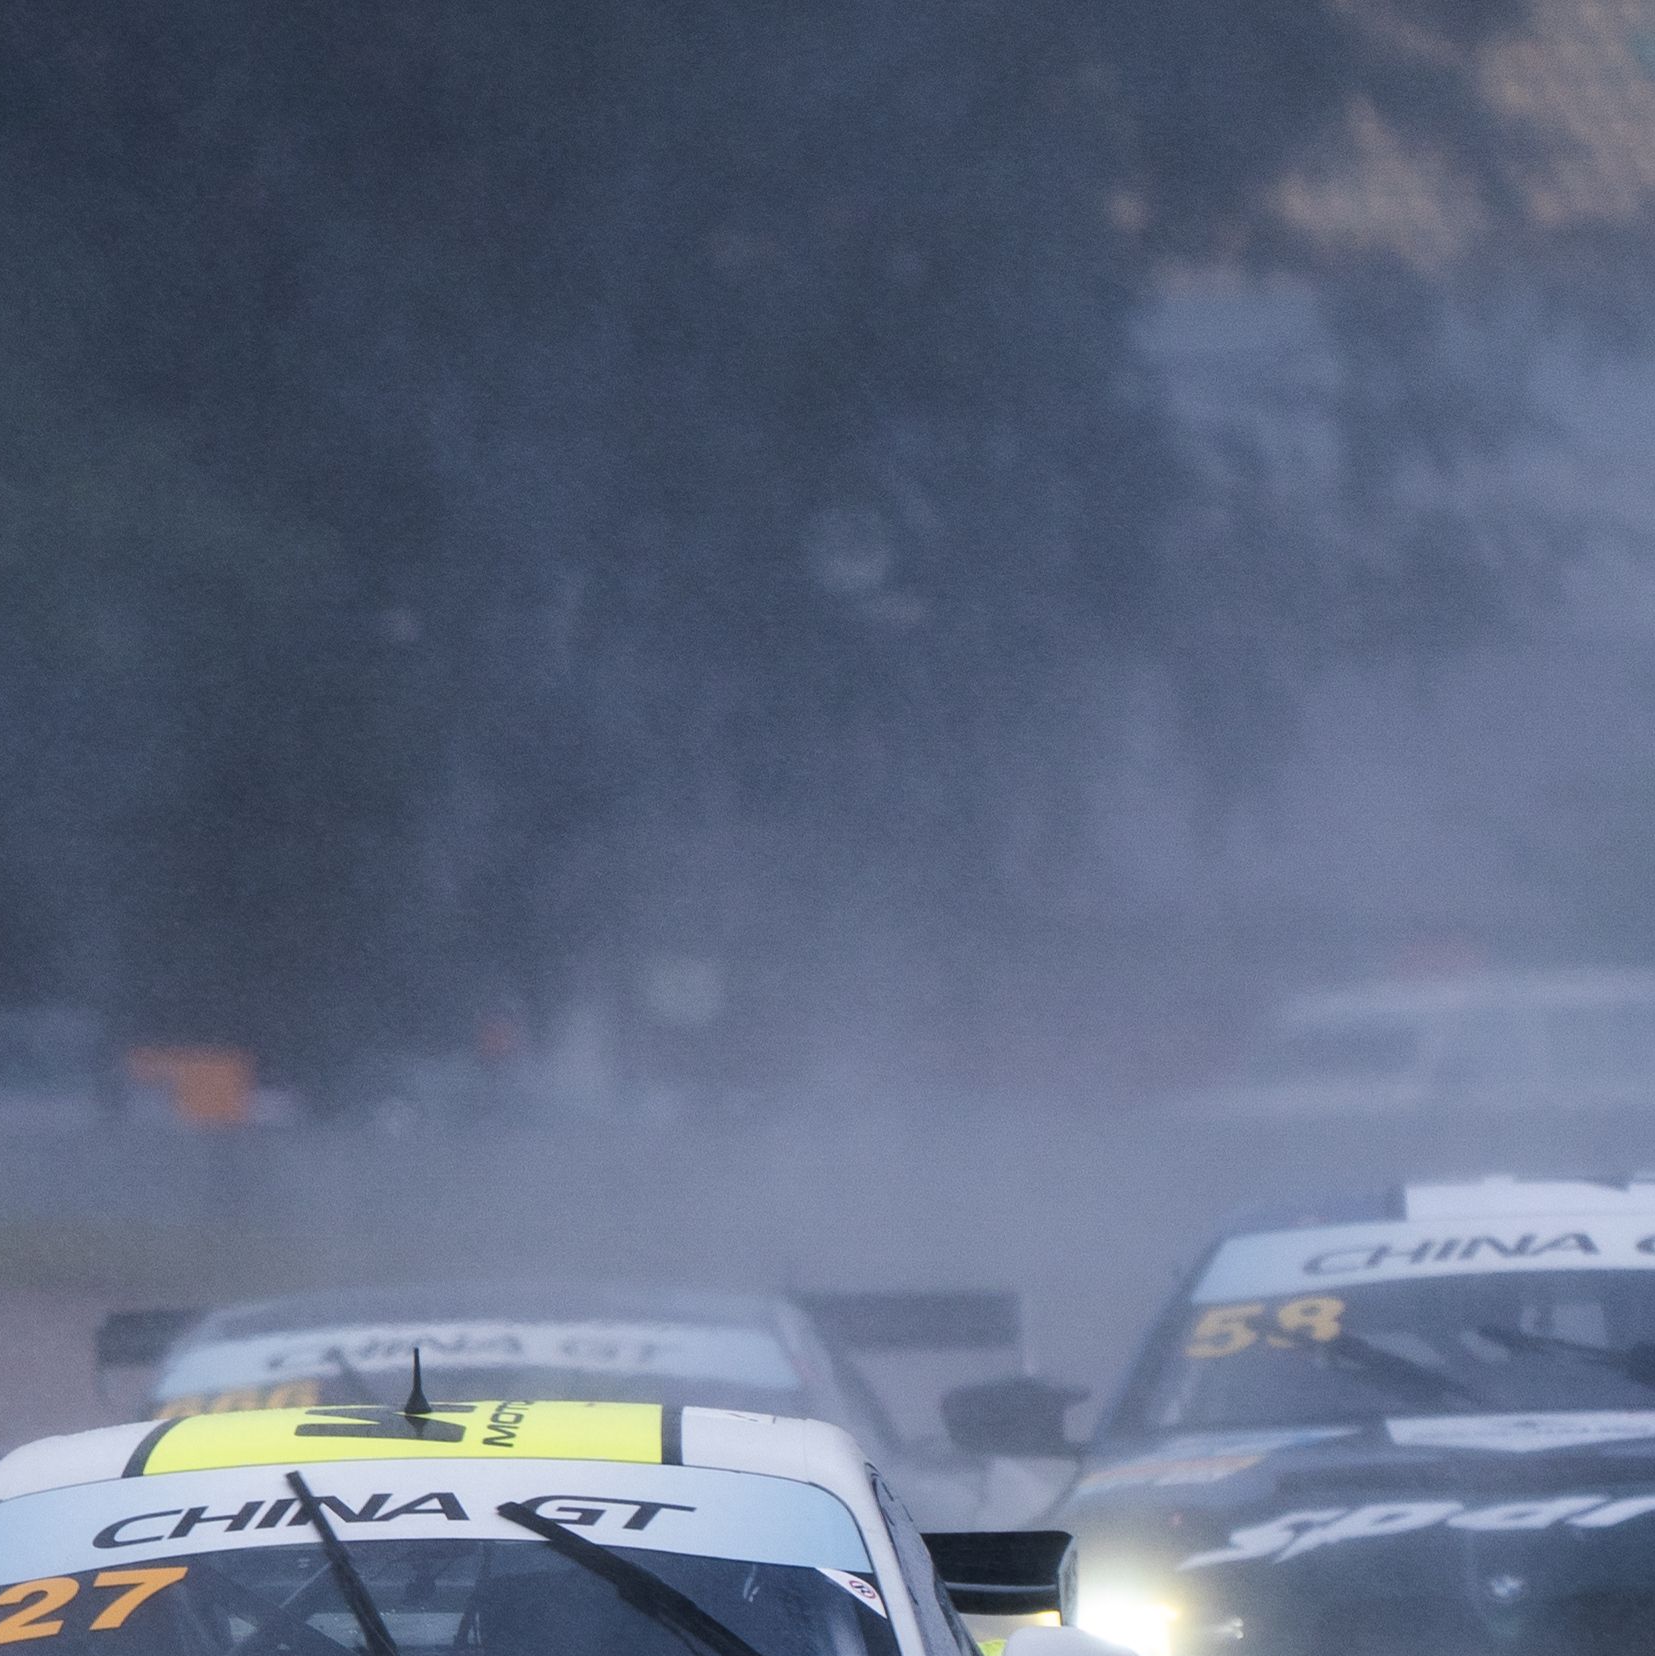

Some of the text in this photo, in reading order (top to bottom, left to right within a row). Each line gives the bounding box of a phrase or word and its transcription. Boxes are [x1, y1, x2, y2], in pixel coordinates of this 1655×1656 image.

[1302, 1231, 1600, 1277] CHINA
[92, 1491, 696, 1550] CHINA GT
